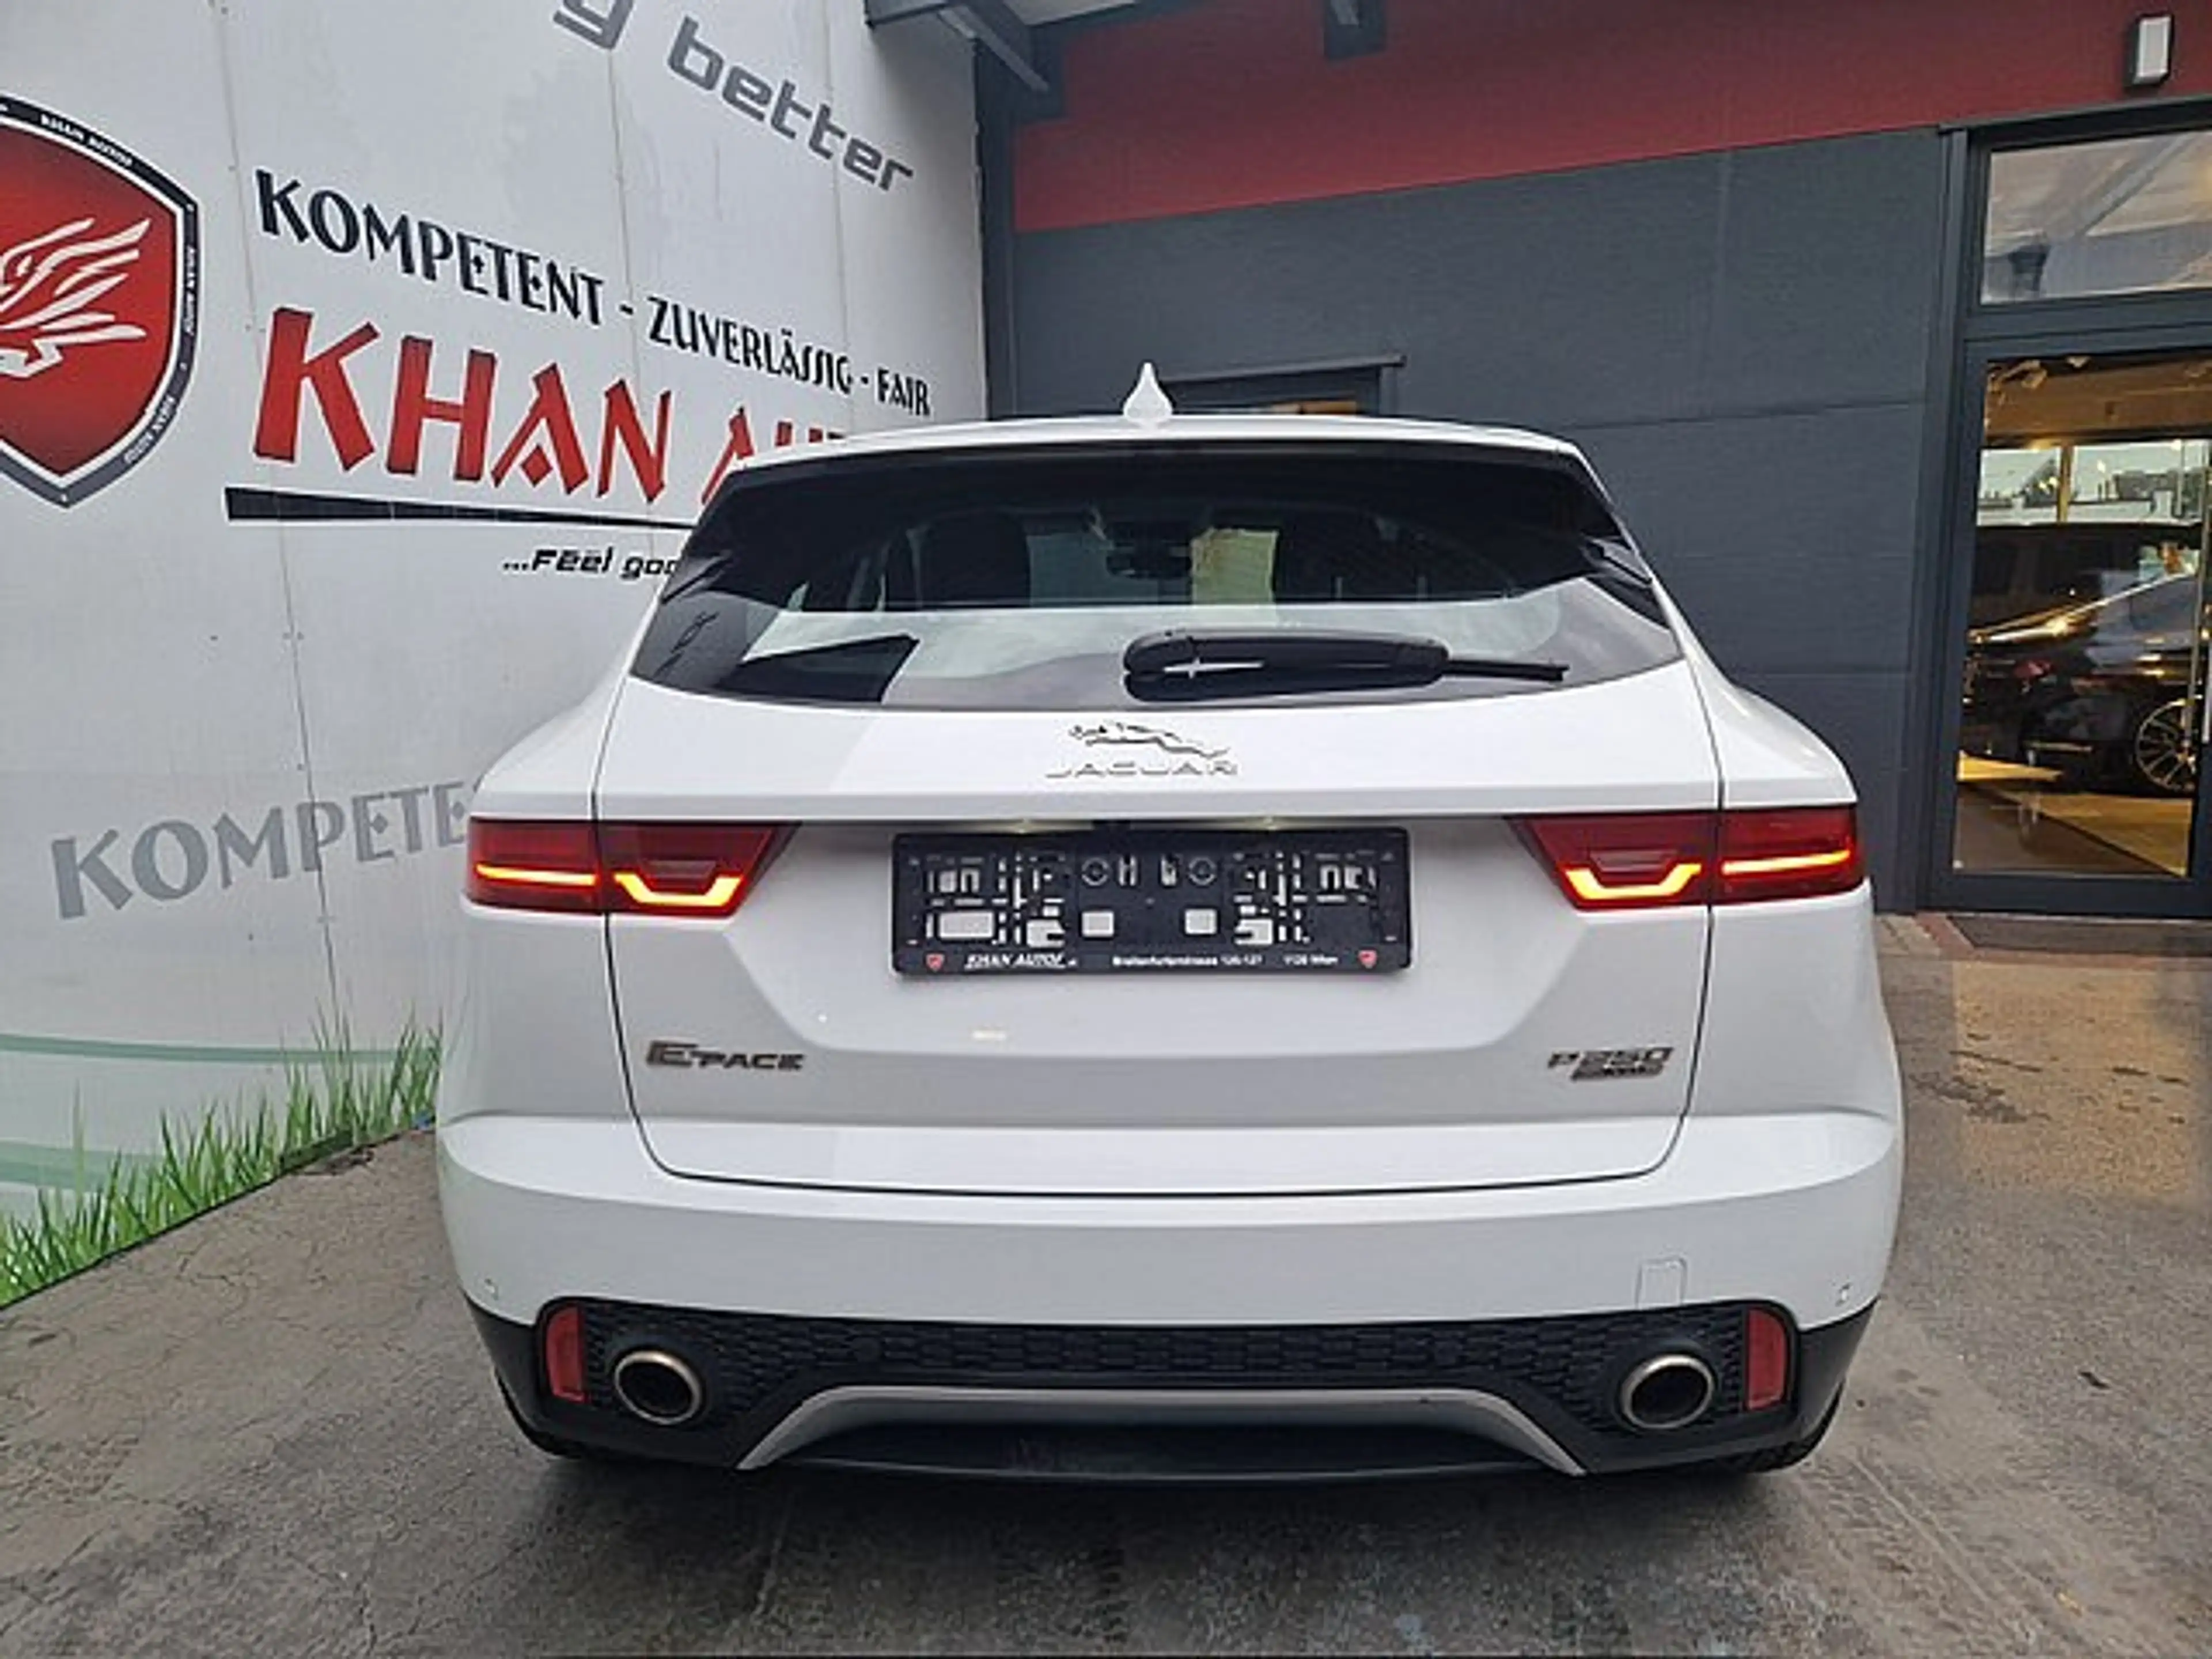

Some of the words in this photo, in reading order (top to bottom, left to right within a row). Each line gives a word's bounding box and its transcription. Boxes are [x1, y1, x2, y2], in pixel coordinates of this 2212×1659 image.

[667, 15, 914, 190] better
[255, 169, 604, 325] KOMPETENT
[647, 296, 854, 394] ZUVERLÄSSIG
[877, 367, 930, 415] FAIR
[253, 306, 672, 503] KHAN
